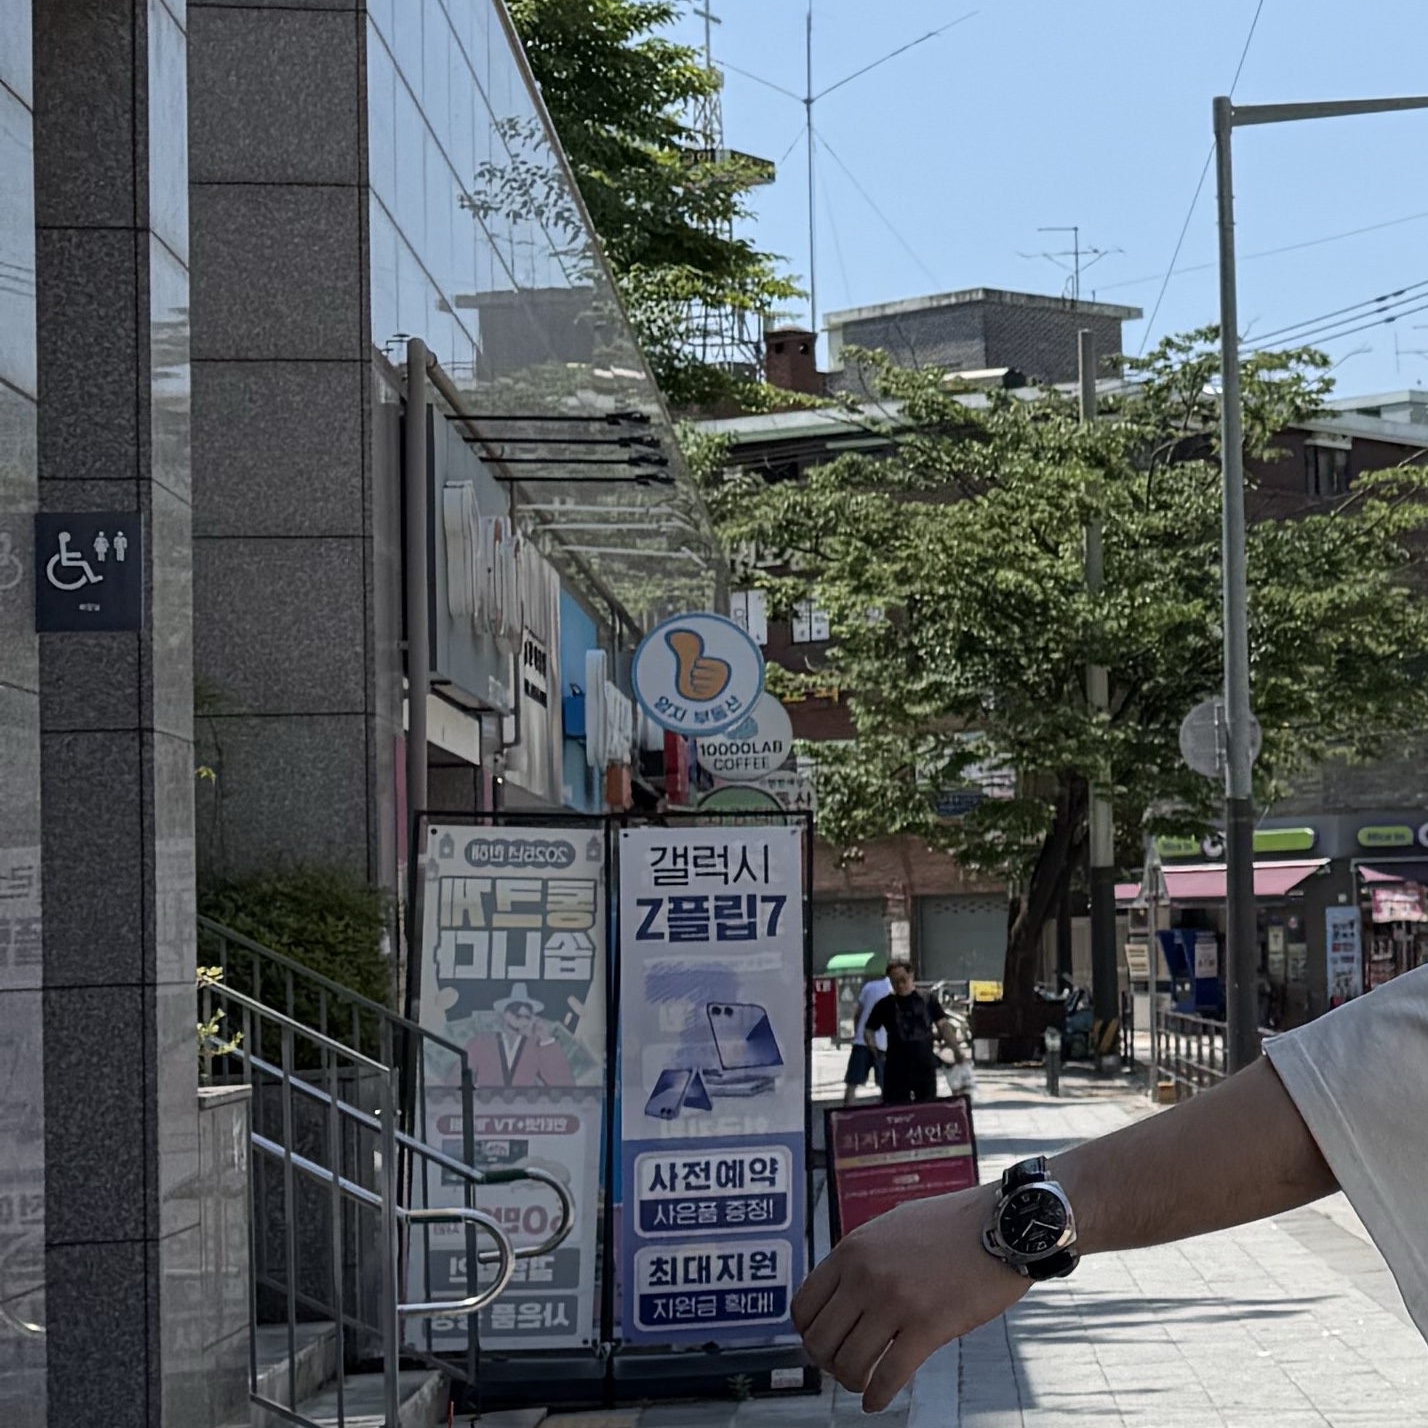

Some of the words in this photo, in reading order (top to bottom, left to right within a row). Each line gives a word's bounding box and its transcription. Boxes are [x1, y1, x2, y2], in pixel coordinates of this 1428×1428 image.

[713, 756, 770, 772] COFFEE
[650, 844, 769, 886] 갤럭시
[635, 894, 788, 943] Z플립7
[648, 1157, 779, 1192] 사전예약
[653, 1202, 718, 1226] 사은품
[648, 1250, 778, 1287] 최대지원
[652, 1294, 717, 1320] 지원금
